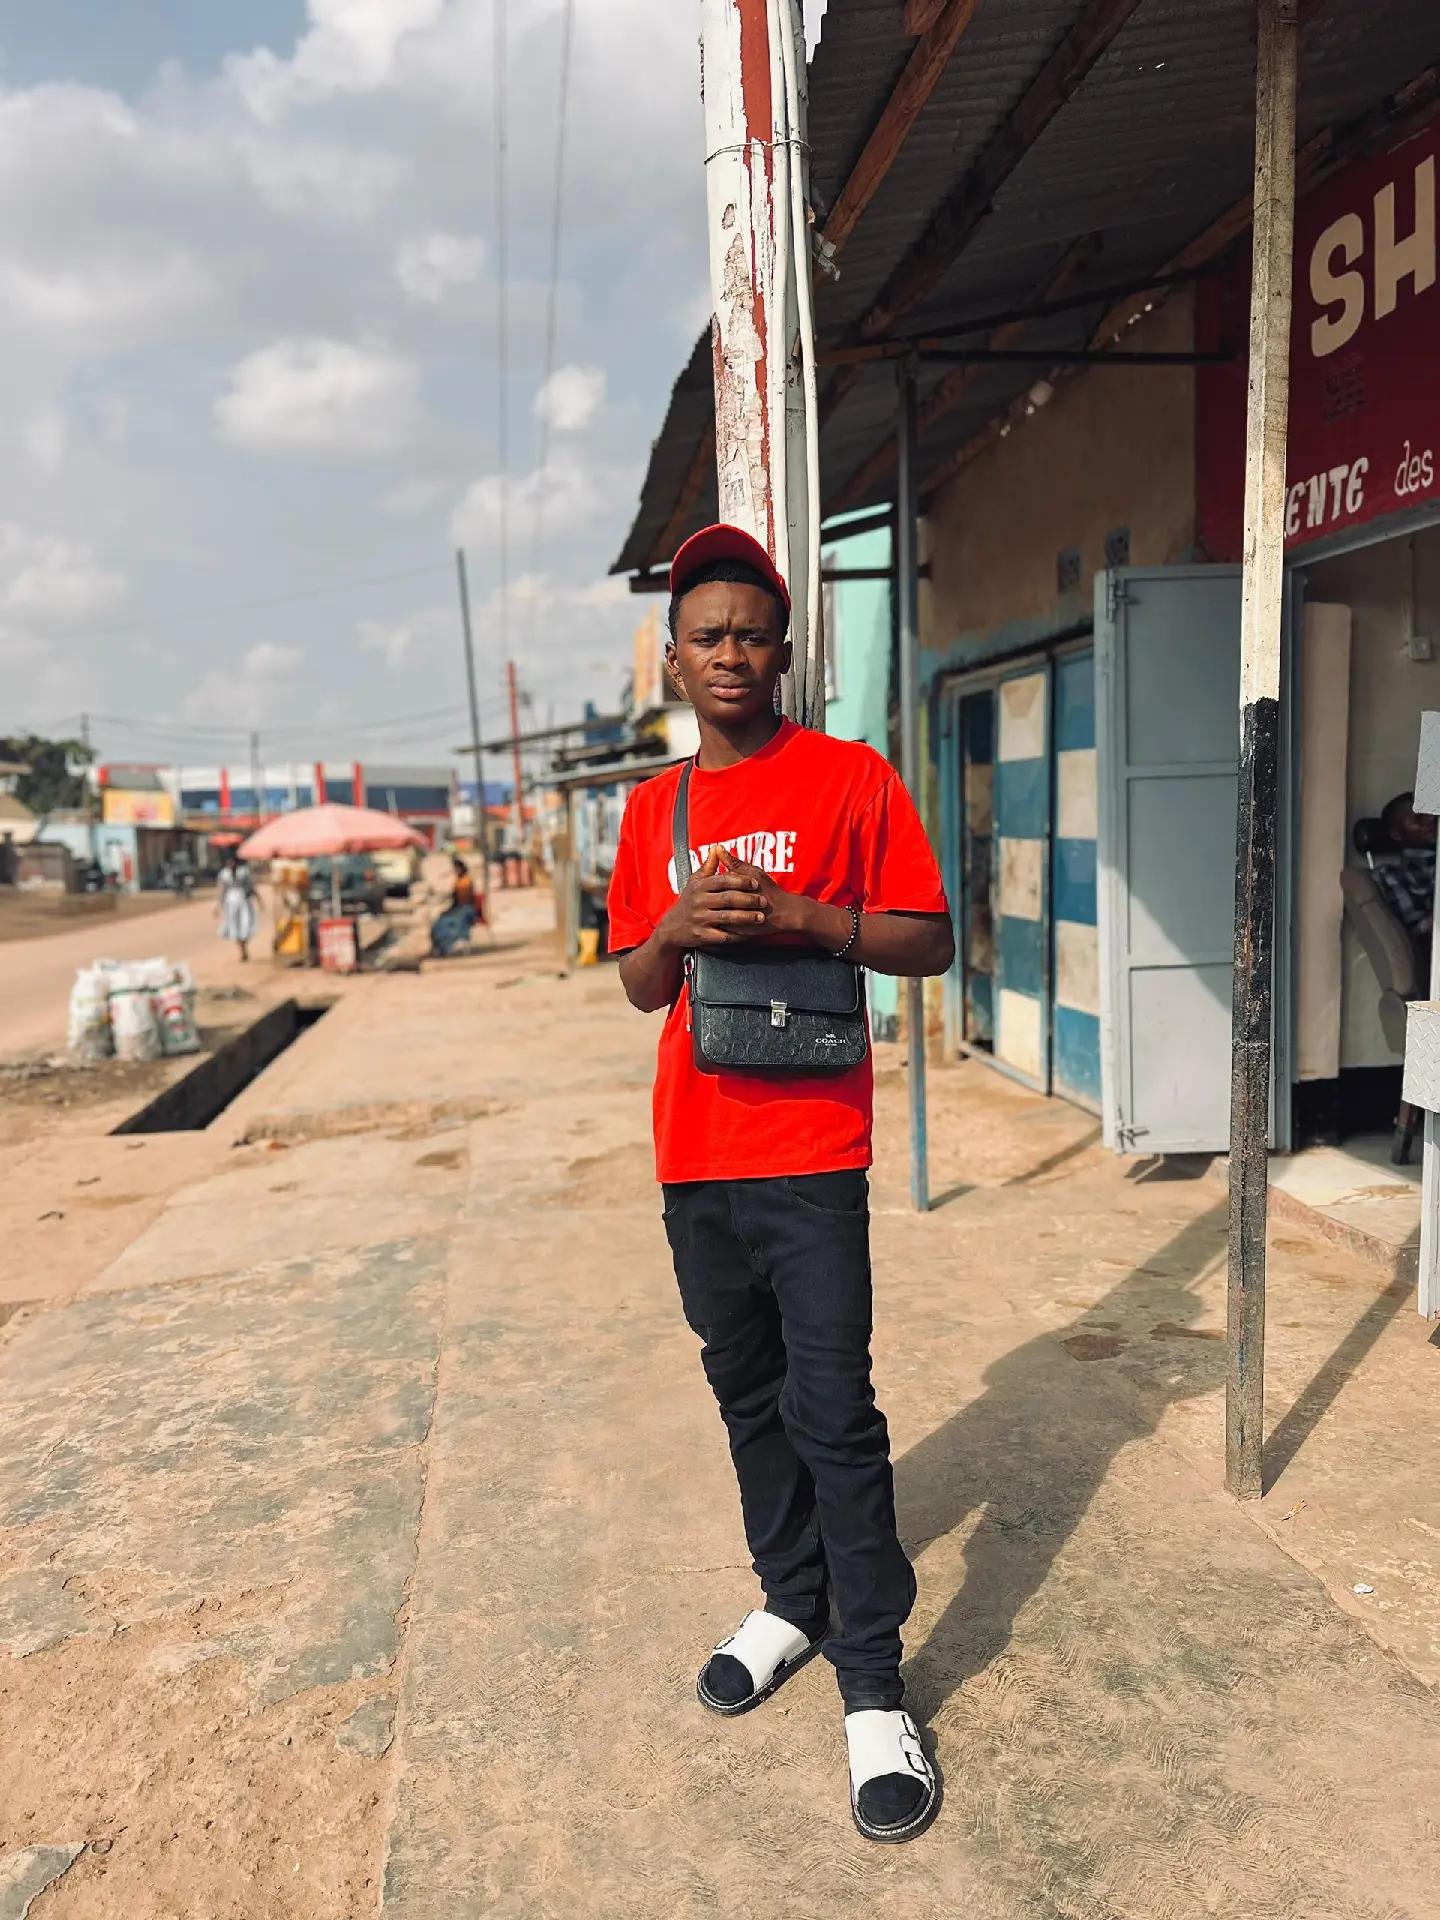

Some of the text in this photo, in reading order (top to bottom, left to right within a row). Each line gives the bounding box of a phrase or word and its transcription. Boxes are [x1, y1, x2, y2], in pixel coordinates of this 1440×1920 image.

[1310, 154, 1436, 357] SH
[1285, 440, 1433, 538] ENTE des
